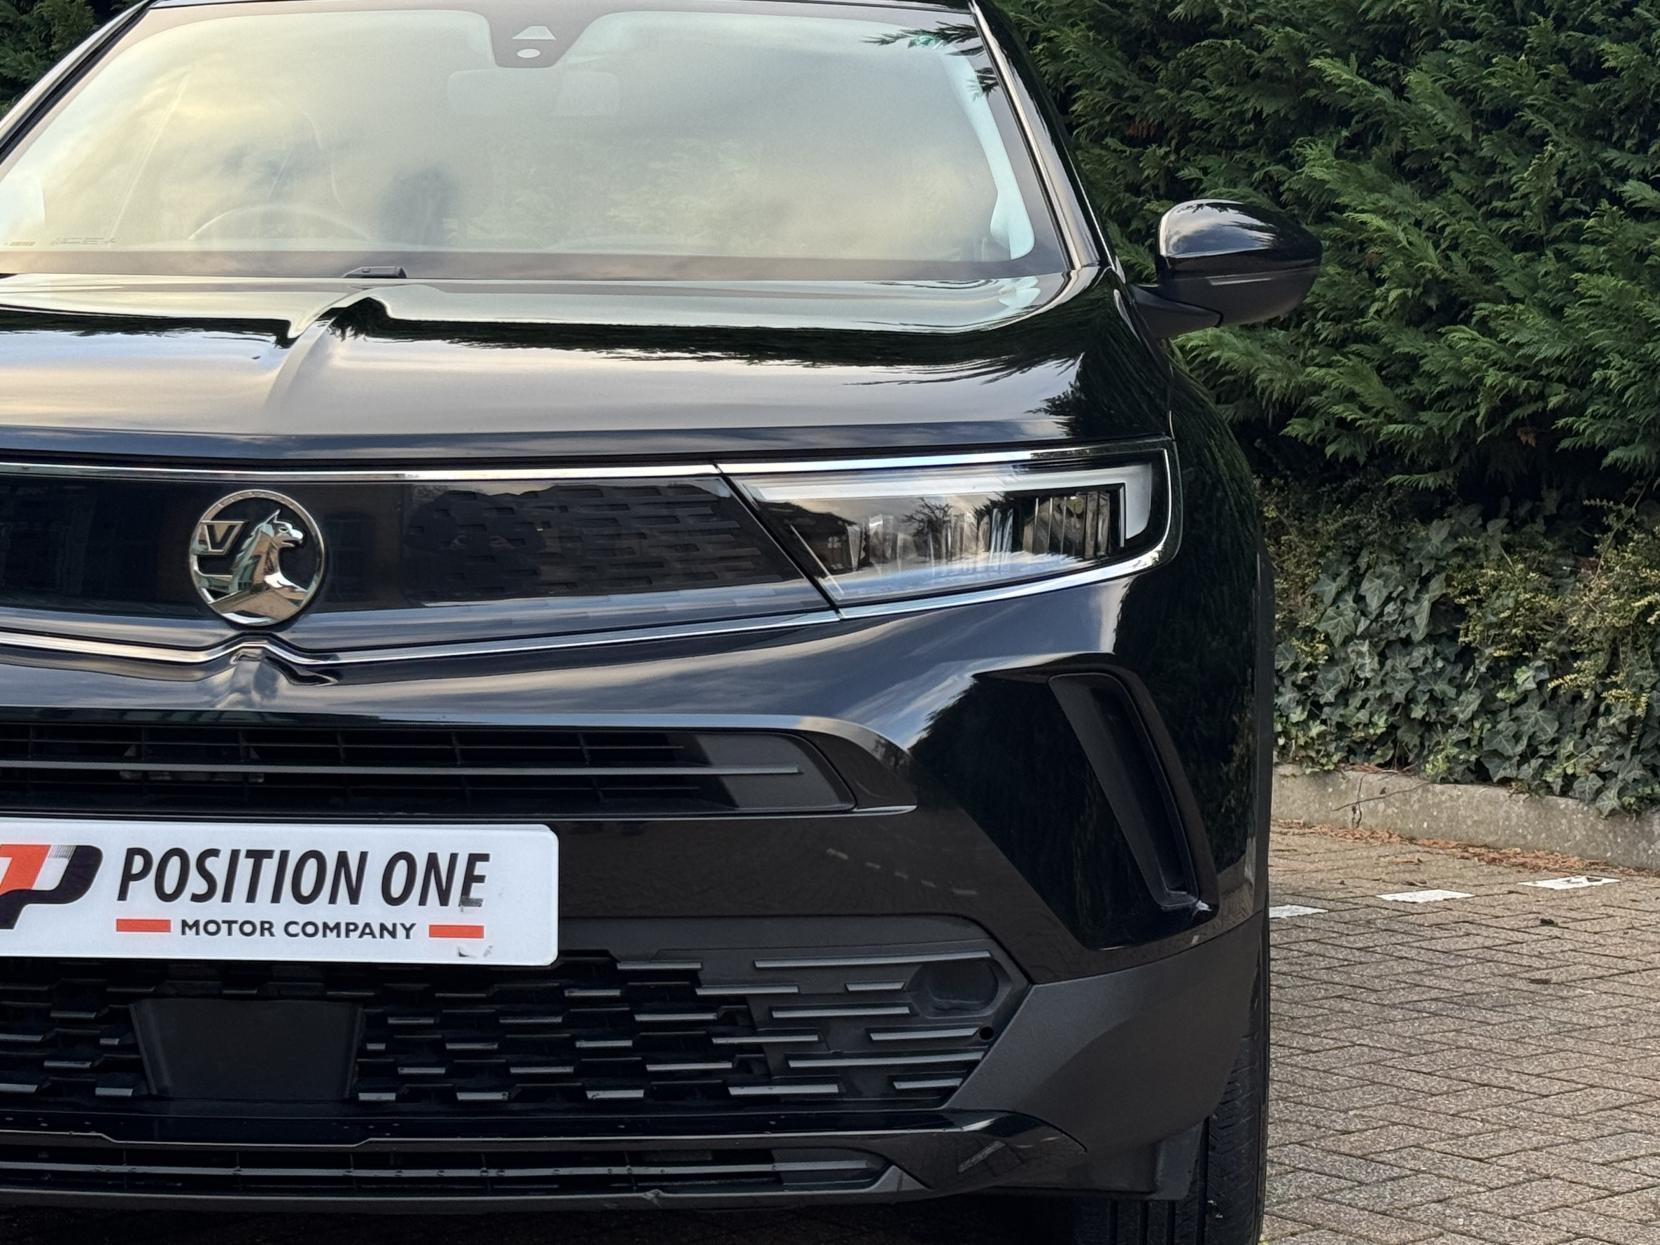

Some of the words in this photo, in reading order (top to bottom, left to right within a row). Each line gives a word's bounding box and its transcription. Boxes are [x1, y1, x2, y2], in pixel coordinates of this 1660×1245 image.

[117, 847, 368, 906] POSITION
[381, 850, 490, 907] ONE
[181, 919, 275, 937] MOTOR
[284, 920, 417, 939] COMPANY
